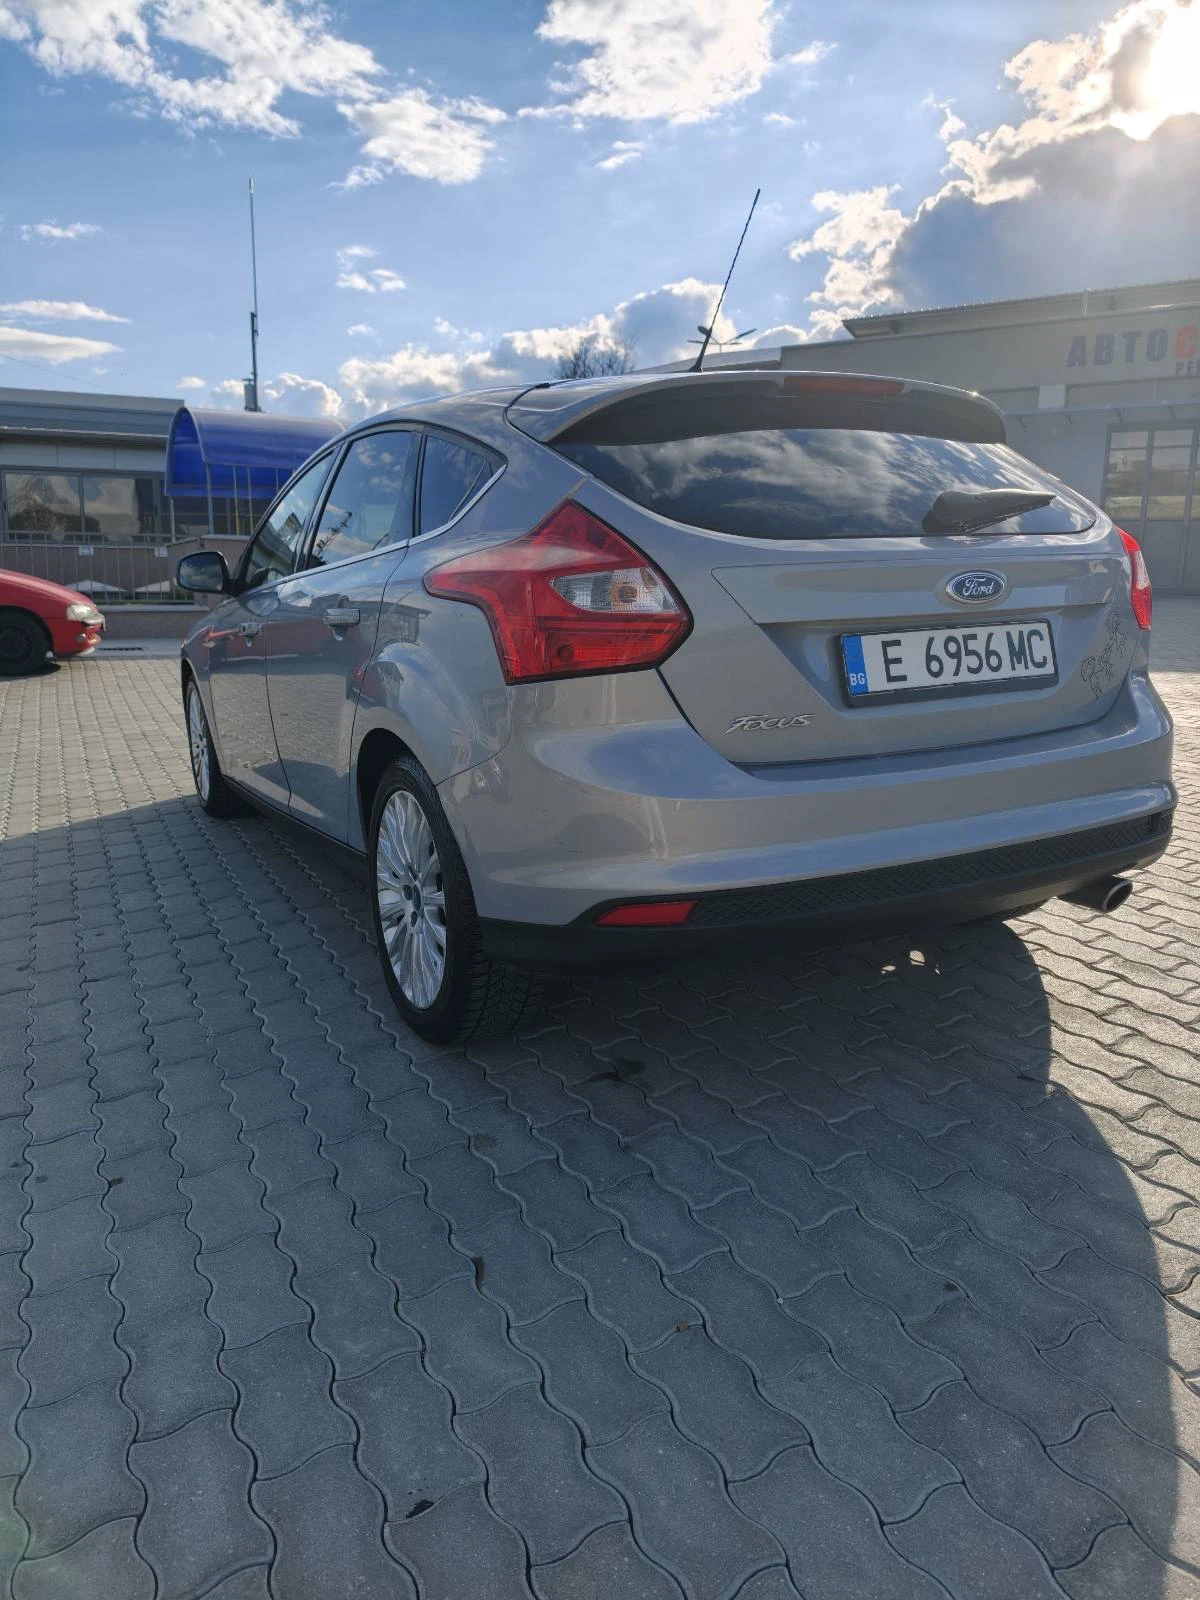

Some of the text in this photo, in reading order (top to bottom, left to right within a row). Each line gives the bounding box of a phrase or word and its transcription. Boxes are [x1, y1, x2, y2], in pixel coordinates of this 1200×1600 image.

[962, 577, 995, 596] Ford
[881, 639, 907, 683] E
[849, 672, 866, 686] BG
